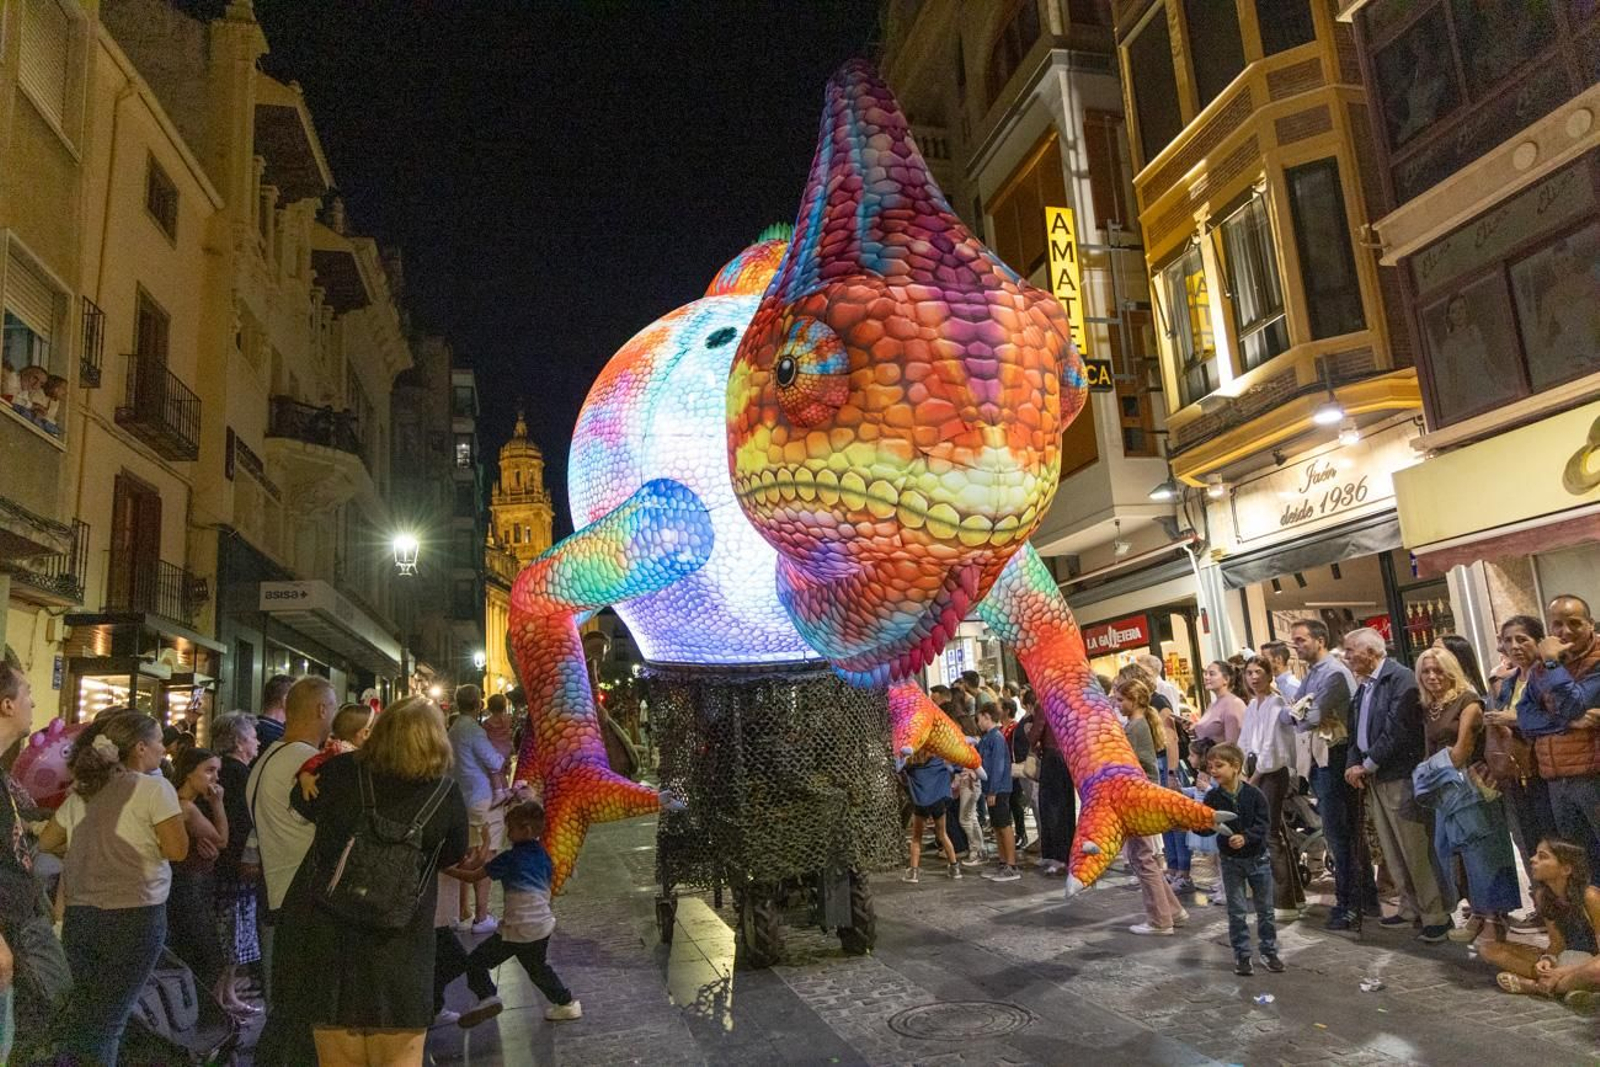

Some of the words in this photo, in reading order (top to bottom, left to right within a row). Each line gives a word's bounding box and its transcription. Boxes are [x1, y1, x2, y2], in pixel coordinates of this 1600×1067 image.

[1298, 459, 1337, 494] Jaén
[1280, 499, 1314, 526] desde
[1319, 475, 1368, 514] 1936
[265, 590, 299, 600] asisa
[1086, 637, 1098, 650] LA
